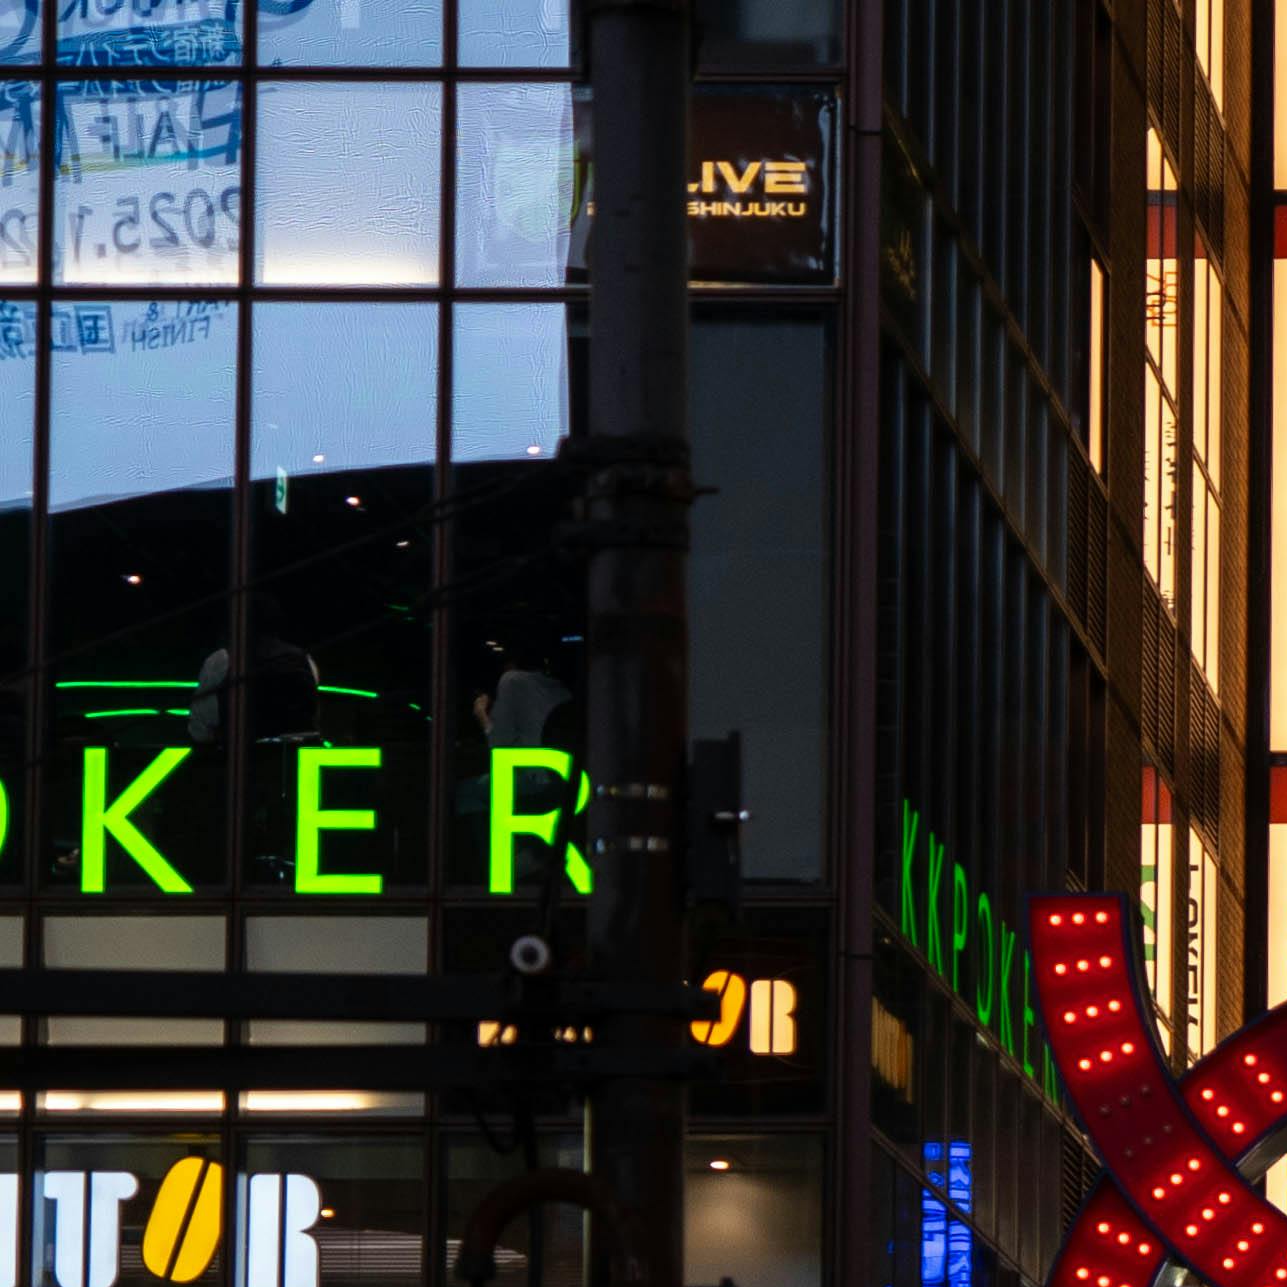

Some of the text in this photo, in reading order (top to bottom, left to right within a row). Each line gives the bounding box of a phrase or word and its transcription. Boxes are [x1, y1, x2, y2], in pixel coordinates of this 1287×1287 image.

[686, 161, 807, 193] IVE
[686, 201, 807, 216] SHINJUKU
[0, 747, 594, 895] KER
